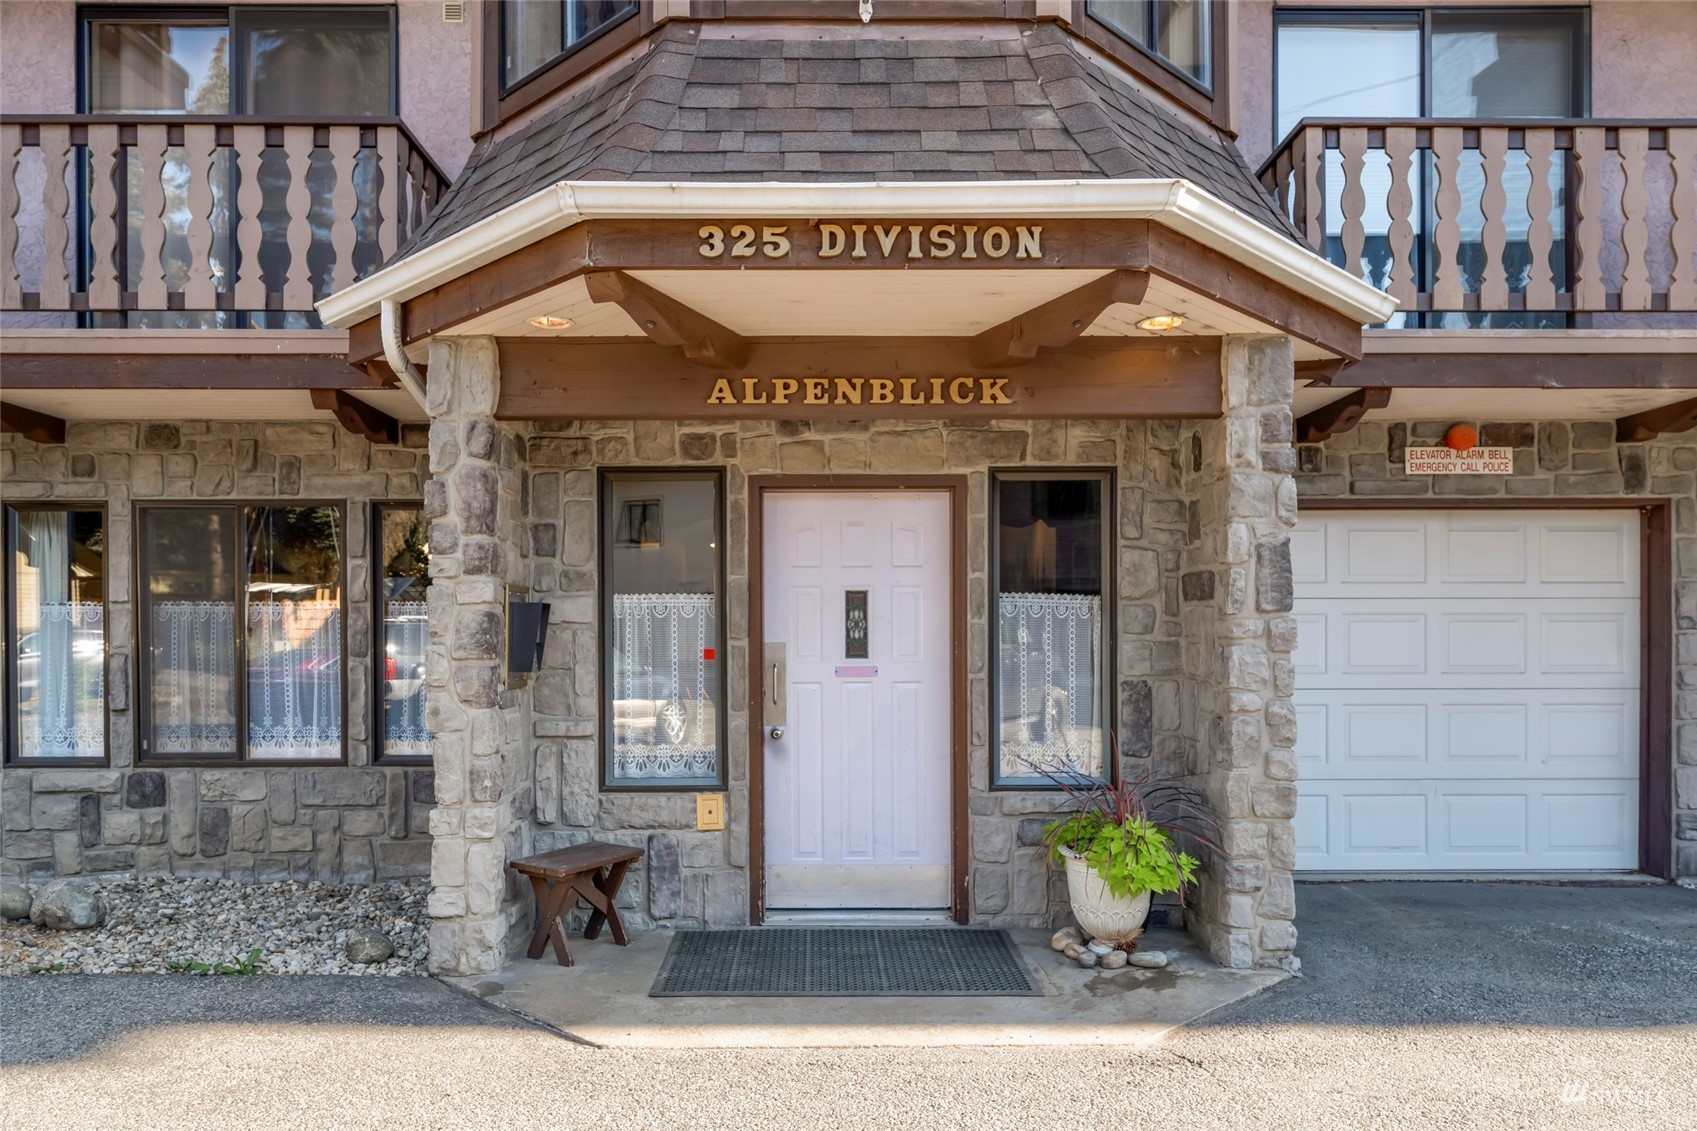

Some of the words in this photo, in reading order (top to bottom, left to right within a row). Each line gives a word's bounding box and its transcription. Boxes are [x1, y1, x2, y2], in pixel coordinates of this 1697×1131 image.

[698, 224, 791, 258] 325
[818, 224, 1043, 259] DIVISION
[706, 377, 1014, 405] ALPENBLICK
[1409, 449, 1452, 460] ELEVATOR
[1455, 449, 1485, 460] ALARM
[1488, 449, 1509, 460] BELL
[1410, 462, 1457, 472] EMERGENCY
[1460, 462, 1480, 472] CALL
[1483, 462, 1509, 472] POLICE
